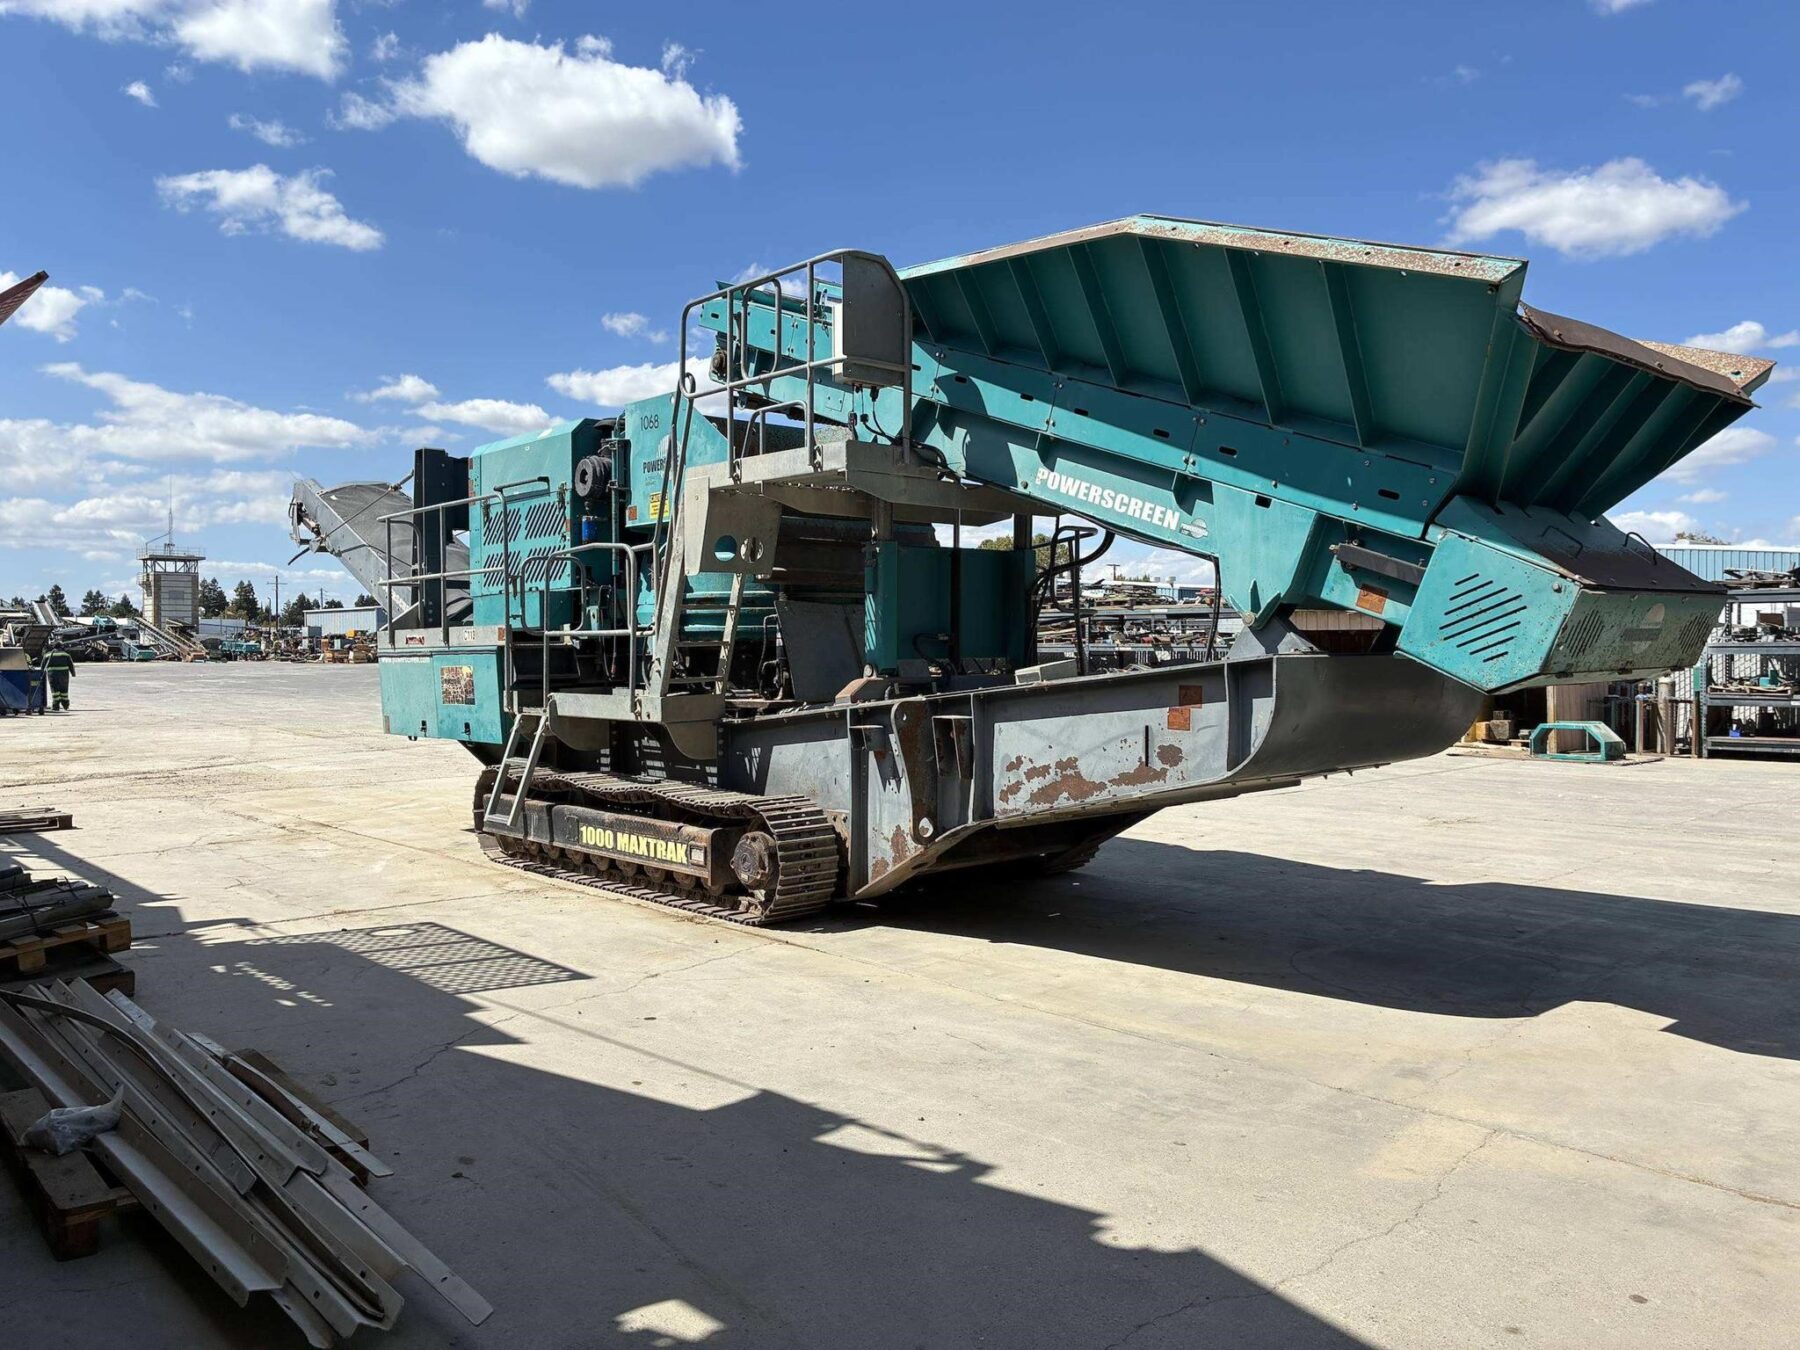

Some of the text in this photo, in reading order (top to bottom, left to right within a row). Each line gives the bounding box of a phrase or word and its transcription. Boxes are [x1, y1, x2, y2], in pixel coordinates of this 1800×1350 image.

[640, 414, 659, 432] 1068
[1035, 467, 1180, 531] POWERSCREEN
[580, 825, 687, 864] 1000 MAXTRAK
